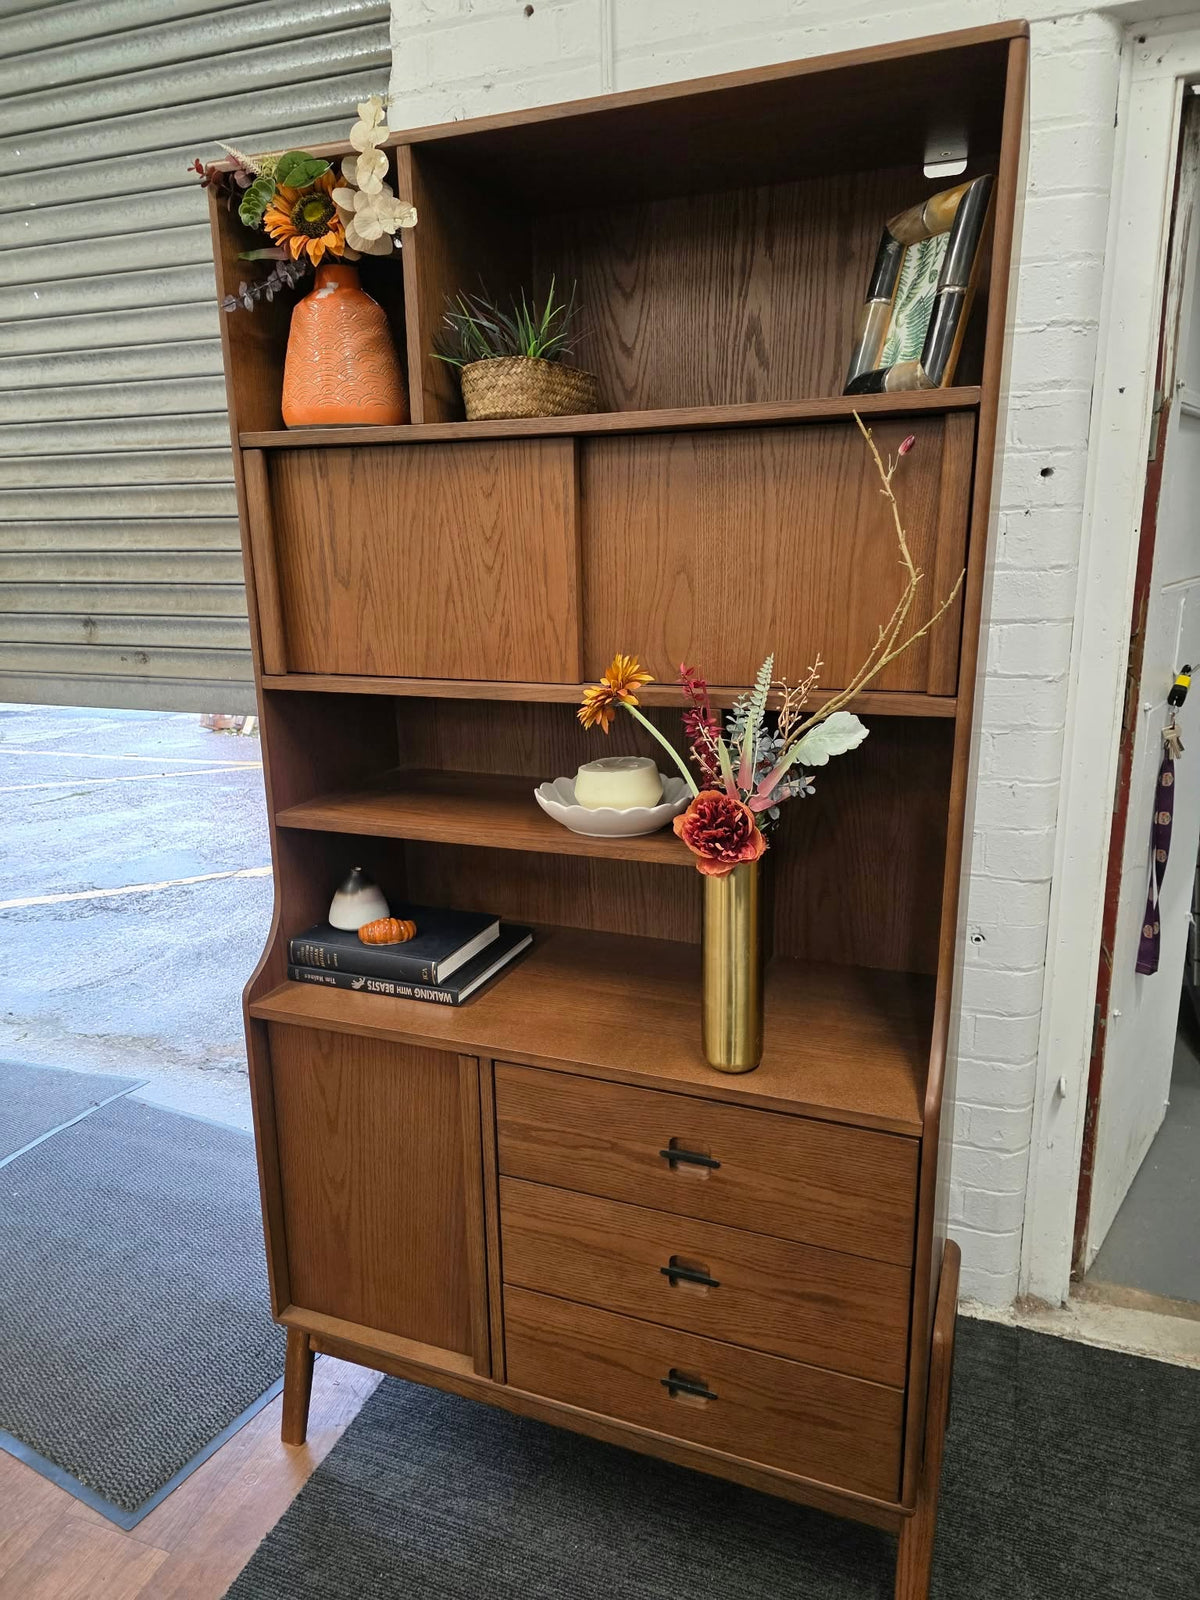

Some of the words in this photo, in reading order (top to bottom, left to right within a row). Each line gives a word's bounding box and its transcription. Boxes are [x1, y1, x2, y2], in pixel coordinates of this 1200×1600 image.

[367, 980, 395, 994] BEASTS
[396, 985, 413, 996] WITH
[413, 988, 453, 1003] WALKING
